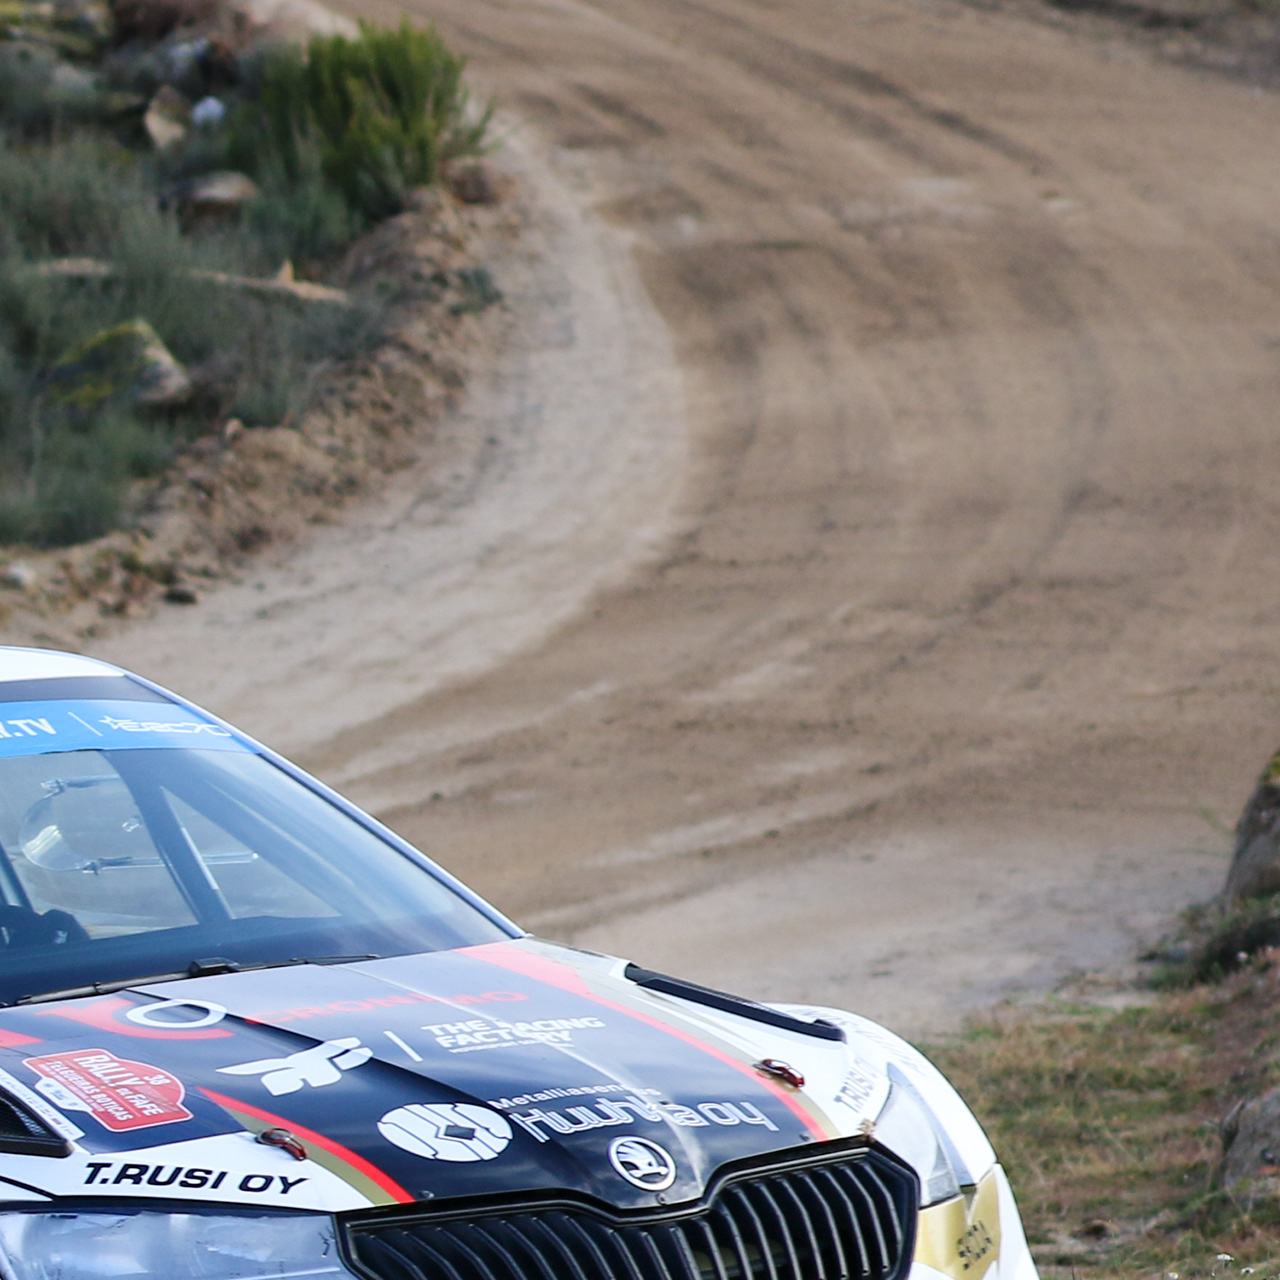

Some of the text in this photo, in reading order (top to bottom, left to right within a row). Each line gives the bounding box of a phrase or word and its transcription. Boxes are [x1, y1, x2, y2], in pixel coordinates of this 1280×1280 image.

[420, 1019, 491, 1036] THE
[73, 1054, 146, 1087] RALLY
[143, 1073, 171, 1086] 38
[46, 1060, 101, 1095] FELGUEIRAS
[90, 1092, 134, 1122] BOTICAS
[127, 1093, 165, 1117] FAFE
[83, 1162, 309, 1195] T.RUSI OY
